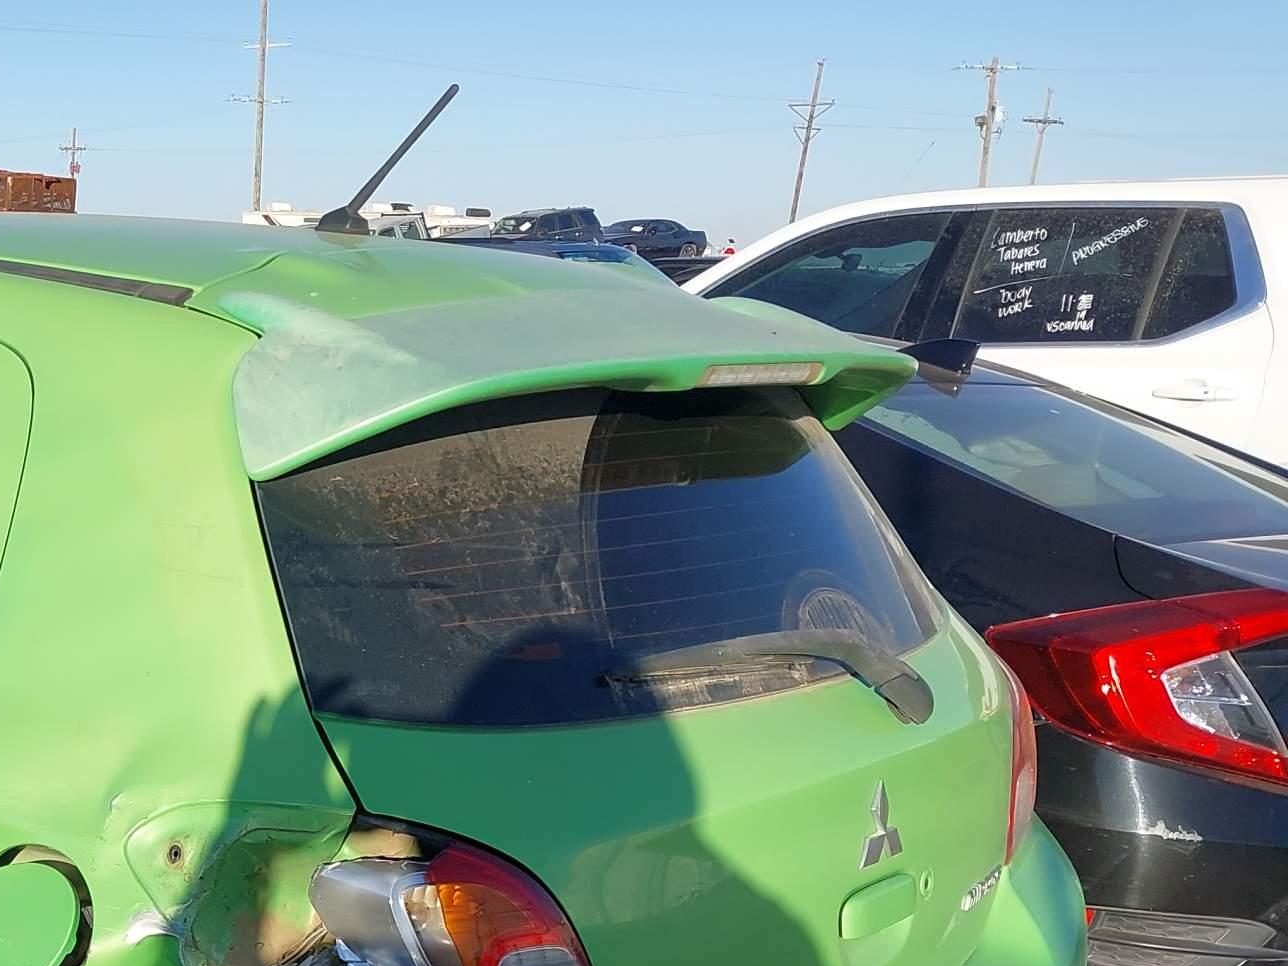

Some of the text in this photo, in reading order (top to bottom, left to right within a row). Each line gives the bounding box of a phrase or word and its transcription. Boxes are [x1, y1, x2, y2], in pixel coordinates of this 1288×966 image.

[991, 226, 1047, 248] Lamberto
[996, 244, 1040, 262] Tabares
[1000, 286, 1033, 303] body
